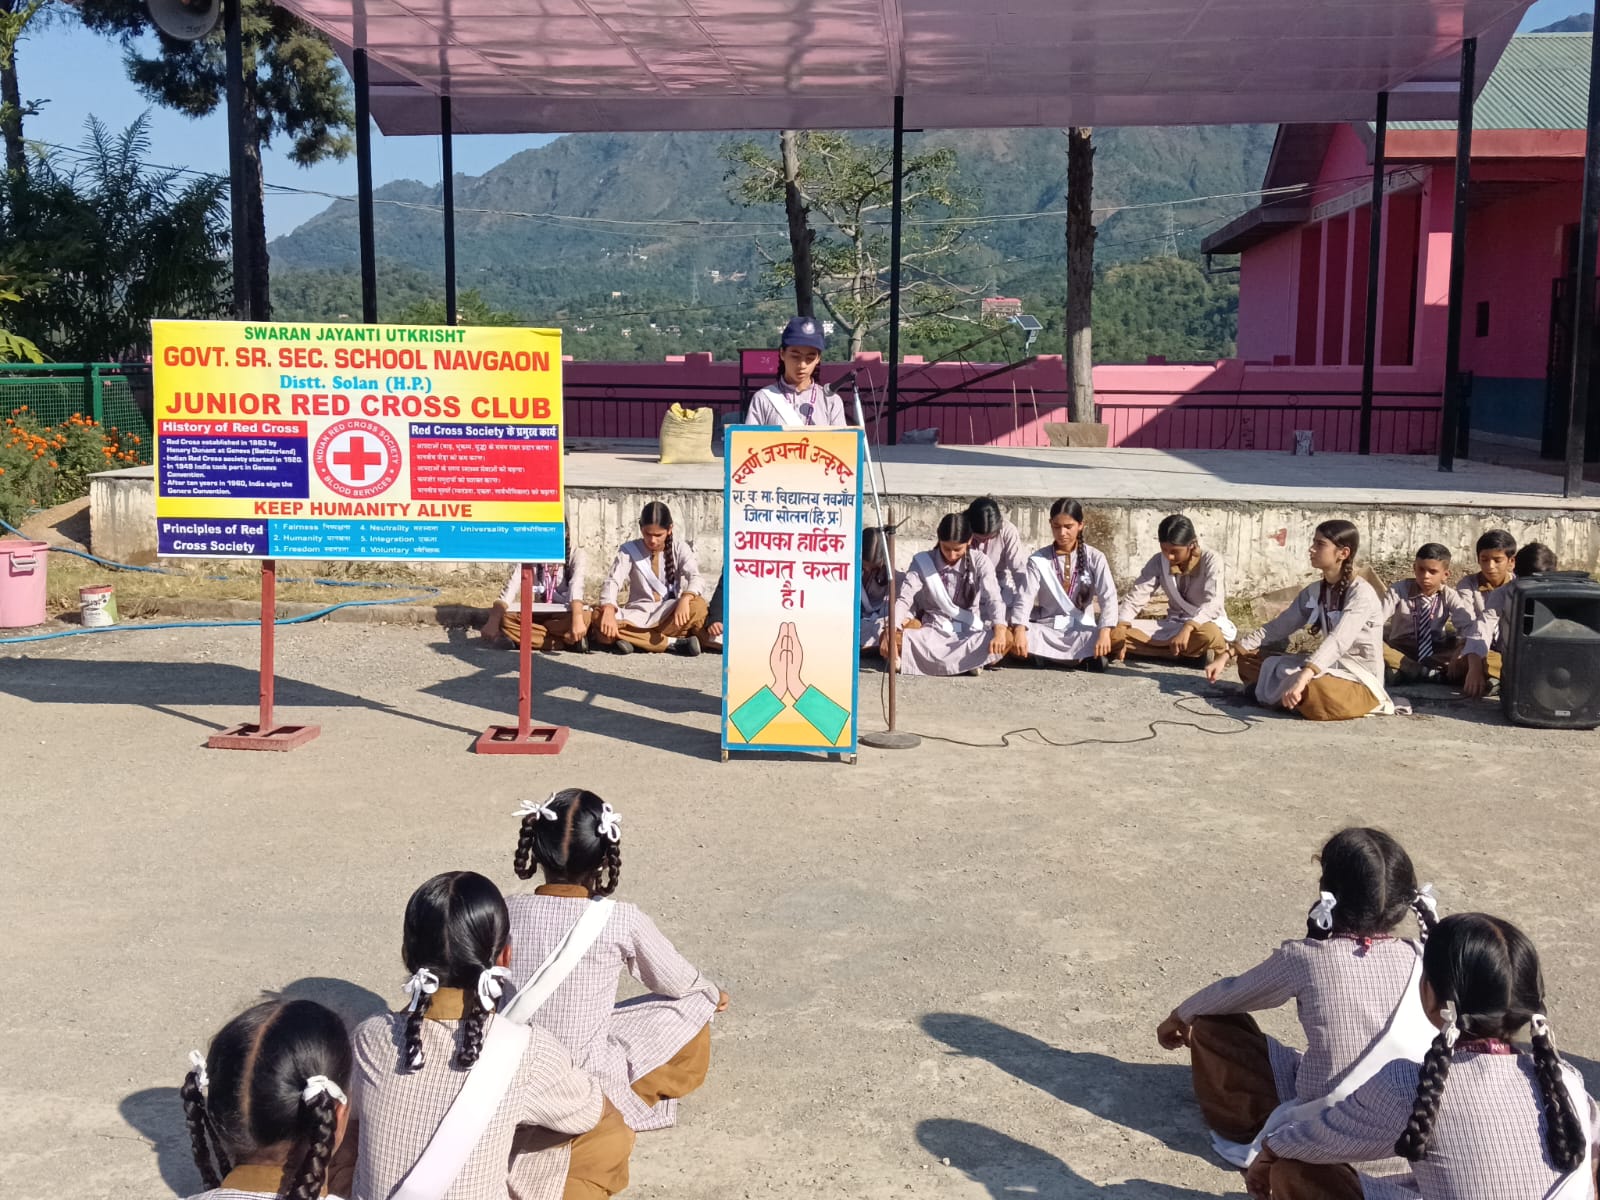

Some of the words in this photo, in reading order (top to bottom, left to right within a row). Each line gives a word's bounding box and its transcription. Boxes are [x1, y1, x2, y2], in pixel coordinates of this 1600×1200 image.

[244, 326, 311, 341] SWARAN
[316, 327, 380, 342] JAYANTI
[386, 329, 466, 343] UTKRISHT
[163, 346, 229, 367] GOVT.
[236, 347, 272, 367] SR.
[279, 347, 328, 368] SEC.
[335, 348, 428, 370] SCHOOL
[434, 350, 550, 371] NAVGAON
[280, 374, 326, 389] Distt.
[332, 375, 379, 390] Solan
[385, 377, 432, 394] (H.P.)
[165, 392, 282, 415] JUNIOR
[292, 393, 350, 415] RED
[361, 394, 461, 417] CROSS
[471, 396, 551, 419] CLUB
[162, 422, 211, 435] History
[215, 422, 228, 433] of
[233, 423, 258, 433] Red
[262, 423, 299, 434] Cross
[411, 425, 431, 435] Red
[434, 425, 463, 436] Cross
[466, 426, 504, 438] Society
[316, 436, 330, 464] INDIAN
[328, 422, 345, 436] RED
[347, 421, 378, 432] CROSS
[379, 430, 400, 465] SOCIETY
[731, 447, 763, 485] स्वर्ण
[810, 445, 855, 484] उत्कृष्ट
[323, 476, 351, 495] BLOOD
[353, 476, 393, 496] SERVICES
[775, 486, 820, 506] विद्यालय
[254, 501, 303, 515] KEEP
[310, 502, 411, 517] HUMANITY
[417, 503, 473, 518] ALIVE
[744, 503, 774, 523] जिला
[163, 523, 222, 536] Principles
[225, 525, 238, 535] of
[241, 525, 264, 535] Red
[282, 523, 319, 531] Fairness
[369, 524, 410, 533] Neutrality
[460, 526, 509, 534] Universality
[173, 540, 207, 551] Cross
[210, 540, 256, 553] Society
[283, 534, 323, 543] Humanity
[369, 535, 415, 543] Integration
[734, 530, 795, 551] आपका
[797, 527, 847, 553] हार्दिक
[369, 546, 410, 555] Voluntary
[733, 558, 796, 580] स्वागत
[802, 561, 851, 583] करता
